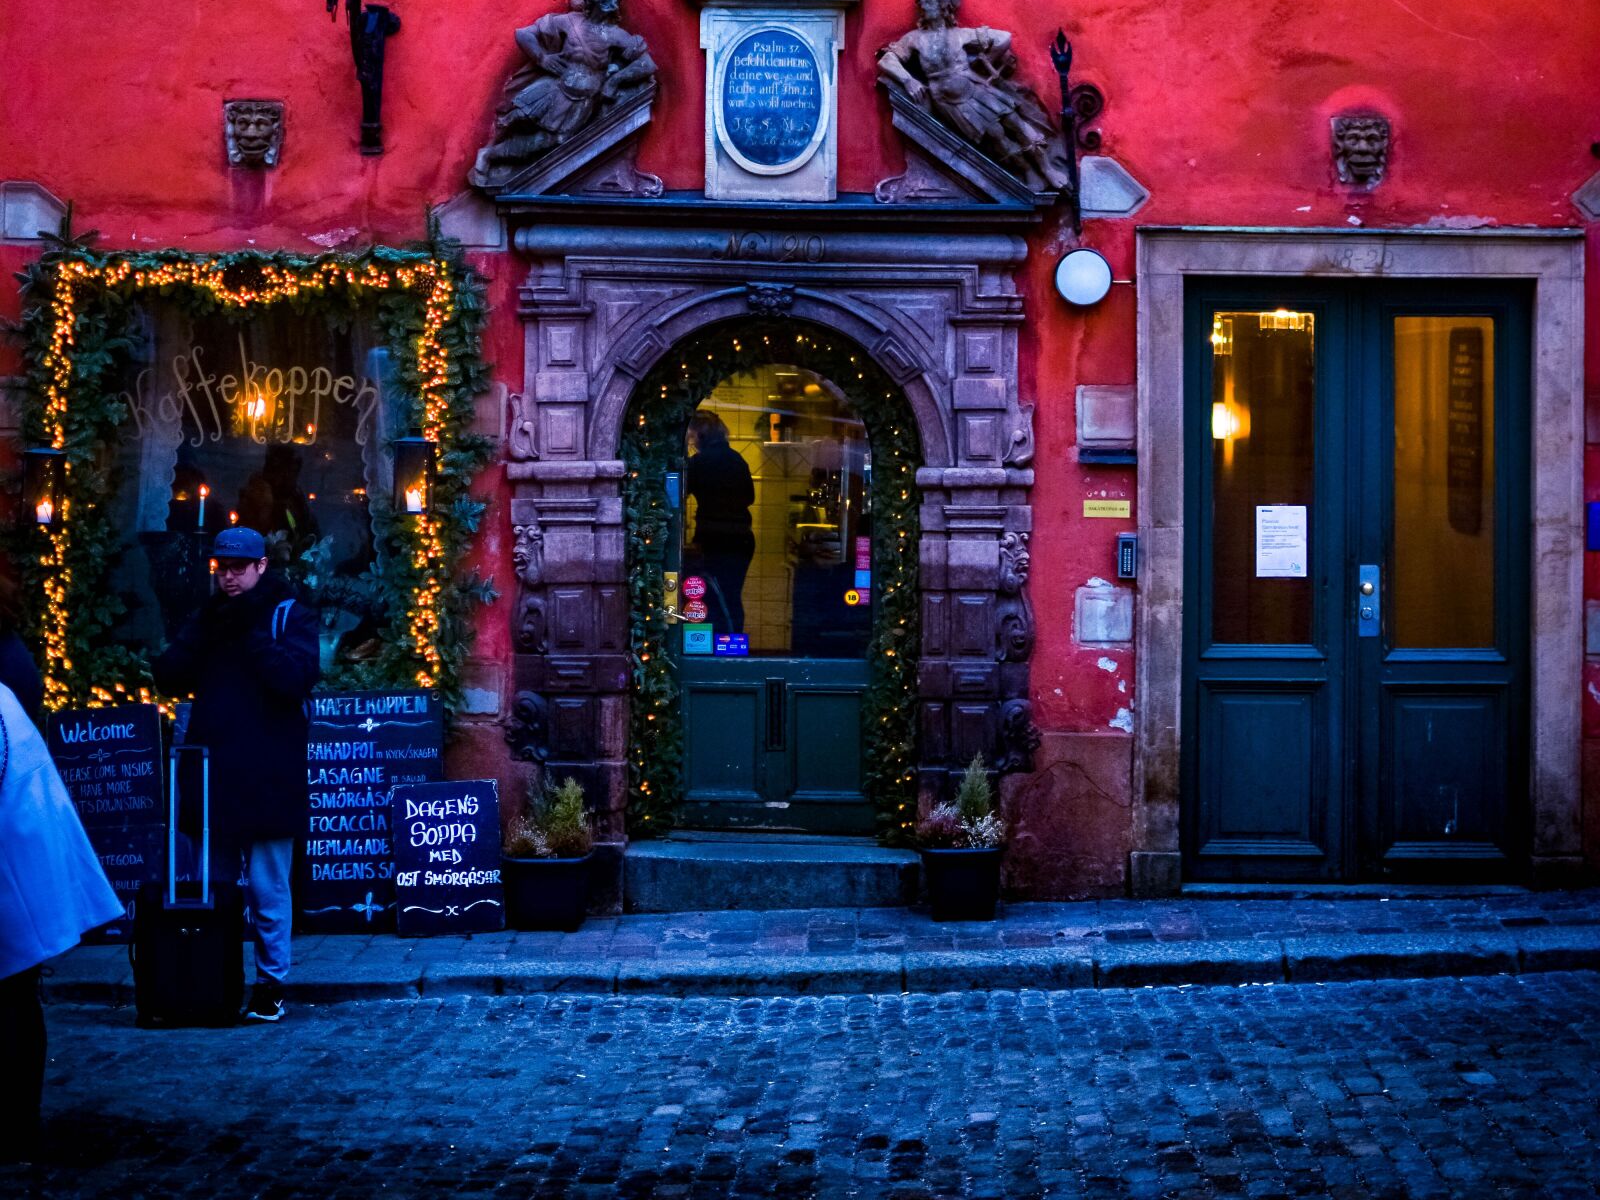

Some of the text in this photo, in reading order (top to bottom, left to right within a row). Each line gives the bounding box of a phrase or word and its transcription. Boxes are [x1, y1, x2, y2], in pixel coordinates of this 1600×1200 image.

[119, 331, 378, 448] Kaffekoppen
[315, 695, 428, 716] KAFFEKOPPEN
[60, 720, 136, 744] Welcome
[94, 764, 117, 780] COME
[121, 761, 154, 777] INSIDE
[307, 766, 385, 785] LASAGNE
[80, 782, 103, 797] HAVE
[106, 781, 133, 794] MORE
[404, 794, 479, 820] DAGENS
[306, 838, 391, 856] HEMLAGADE
[428, 848, 463, 865] MED
[312, 862, 375, 881] DAGENS
[396, 866, 503, 888] OST SMÖRGÅSAR
